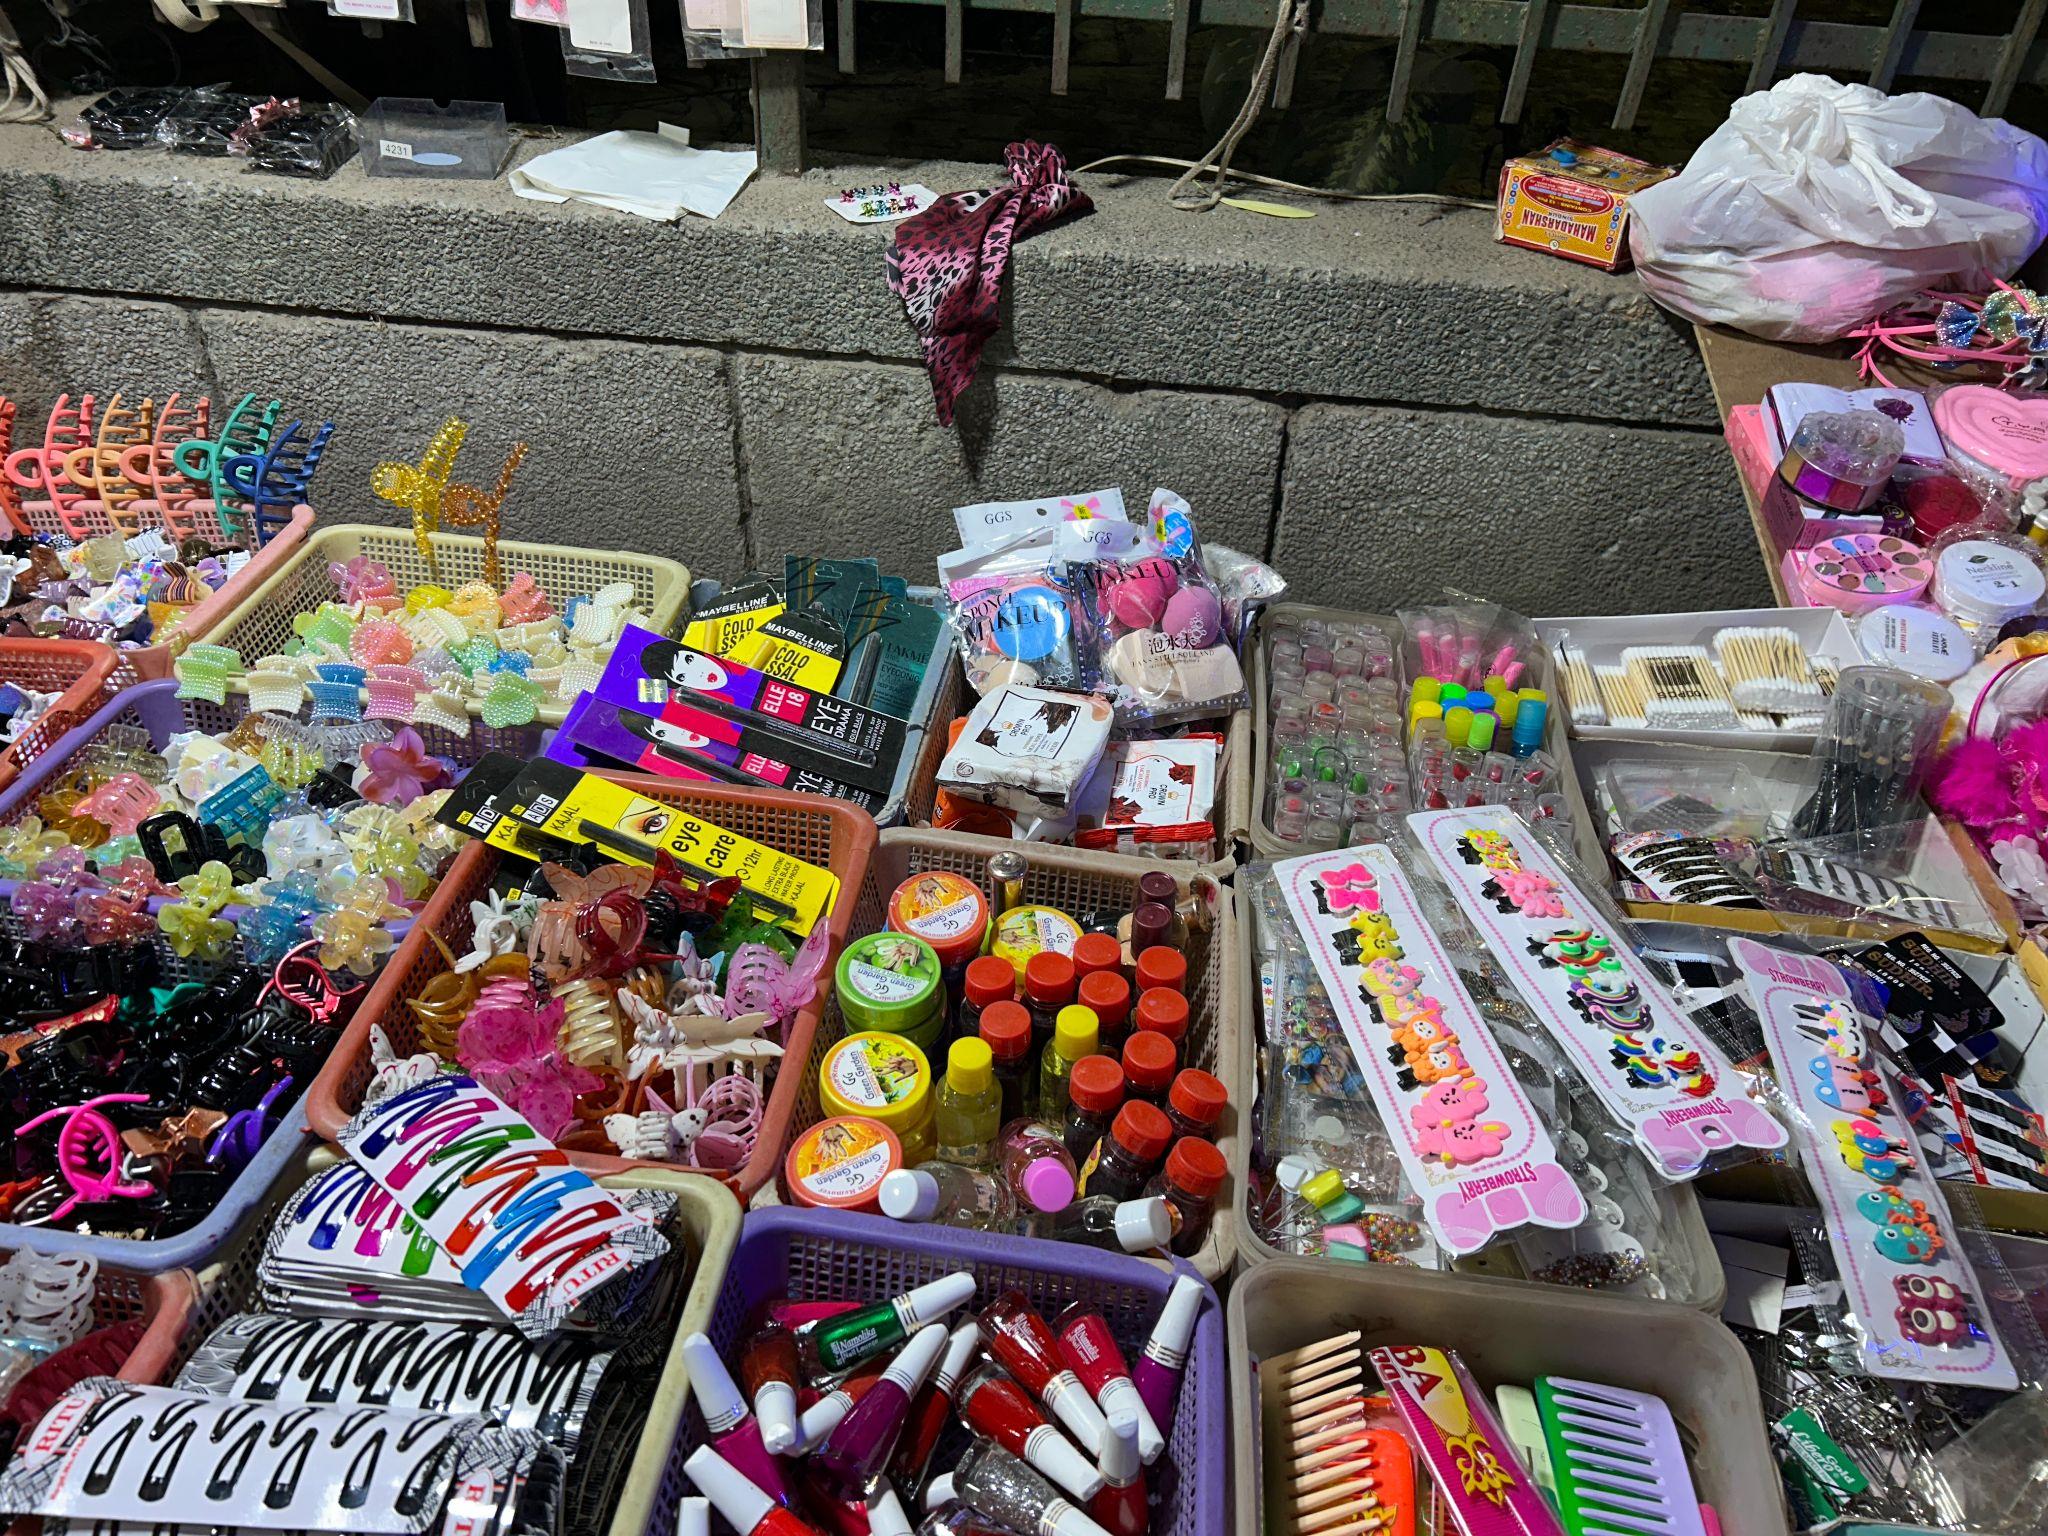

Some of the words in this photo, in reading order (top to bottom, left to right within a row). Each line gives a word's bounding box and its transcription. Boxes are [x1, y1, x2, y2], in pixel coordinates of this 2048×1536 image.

[385, 145, 407, 156] 4231
[1521, 209, 1598, 243] MAHADARSHAN
[984, 511, 1013, 525] GGS
[1083, 531, 1113, 544] GGS
[699, 596, 768, 618] MAYBELLINE
[723, 617, 754, 637] COLO
[765, 622, 836, 653] MAYBELLINE
[775, 647, 810, 669] COLO
[765, 661, 799, 683] SSAL
[763, 685, 787, 714] ELLE
[786, 691, 805, 708] 18
[811, 699, 842, 735] EYE
[833, 708, 853, 739] DRAMA
[853, 712, 863, 728] BLACK
[1009, 718, 1025, 737] CROWN
[1020, 724, 1033, 736] PRO
[1148, 787, 1157, 800] PRO
[1158, 783, 1168, 806] CROWN
[530, 796, 555, 822] ADS
[550, 806, 580, 831] KAJAL
[671, 821, 702, 853] eye
[705, 834, 736, 869] care
[744, 849, 763, 869] 12hr
[764, 876, 775, 890] LONG
[771, 856, 785, 876] LASTING
[772, 878, 783, 893] EXTRA
[780, 861, 792, 877] BLACK
[781, 880, 792, 897] WATER
[789, 864, 800, 880] PROOF
[790, 882, 806, 900] KAJAL
[918, 913, 947, 928] Garden
[948, 903, 972, 917] Green
[943, 920, 959, 930] GG
[1043, 918, 1052, 937] Green
[1057, 932, 1068, 944] GG
[858, 968, 888, 983] Garden
[890, 978, 915, 990] Green
[1768, 968, 1829, 996] STROWBERRY
[1867, 951, 1934, 998] SUDHIR
[874, 983, 889, 994] GG
[851, 1051, 865, 1077] Garden
[843, 1072, 856, 1085] GG
[862, 1079, 875, 1100] Green
[1658, 1097, 1733, 1128] STROWBERRY
[853, 1153, 881, 1170] Green
[816, 1170, 851, 1186] Garden
[846, 1174, 865, 1186] GG
[1458, 1161, 1537, 1203] STROWBERRY
[563, 1252, 621, 1295] RITU
[840, 1328, 877, 1349] Namolika
[35, 1399, 87, 1452] RITU
[1793, 1431, 1834, 1472] Libero
[1826, 1455, 1856, 1484] Gold
